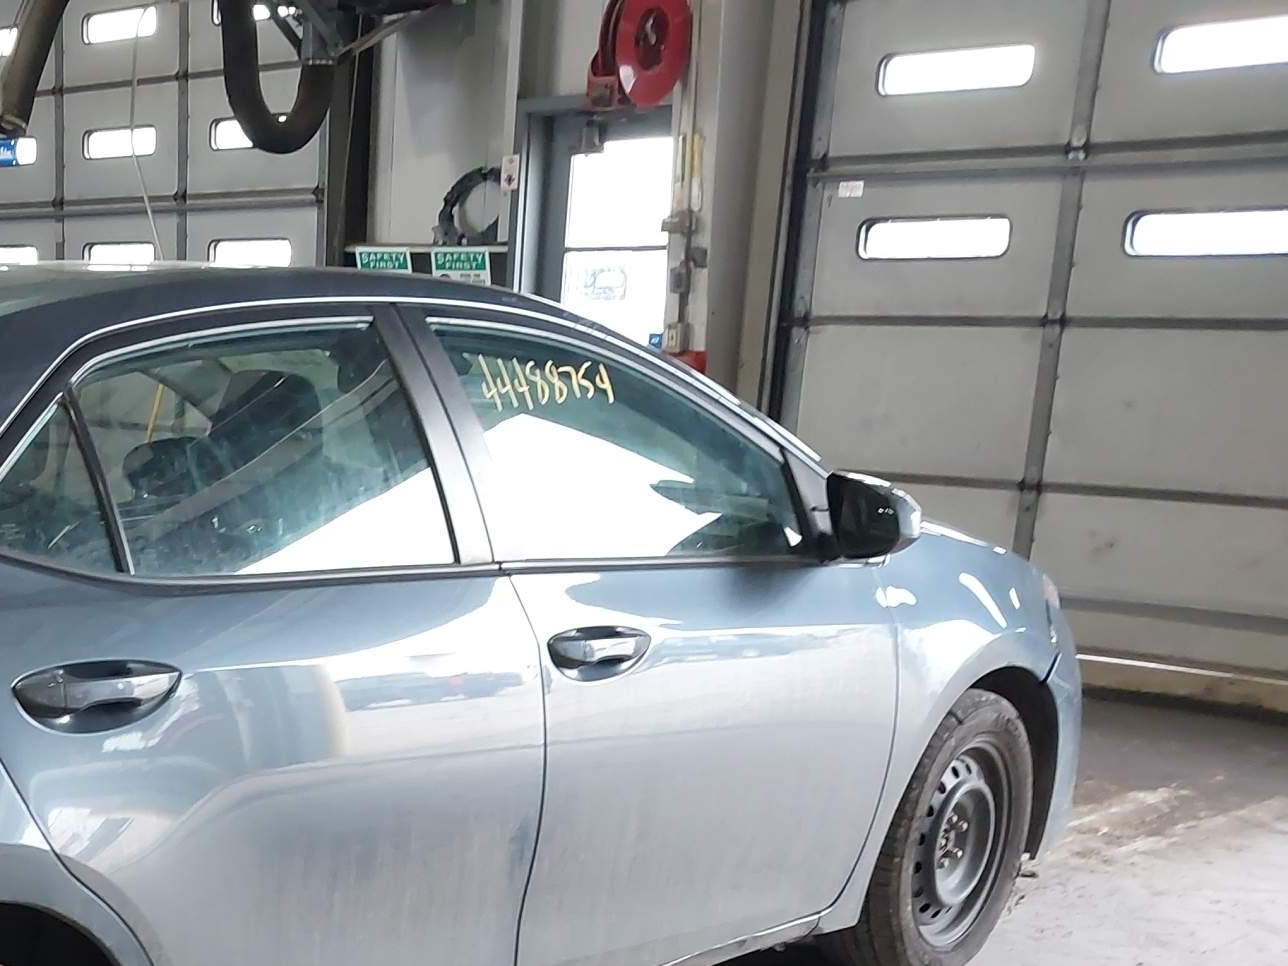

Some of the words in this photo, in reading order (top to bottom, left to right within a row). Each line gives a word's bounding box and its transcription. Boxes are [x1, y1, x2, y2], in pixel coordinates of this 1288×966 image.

[361, 252, 405, 264] SAFETY
[436, 252, 483, 264] SAFETY
[369, 261, 401, 270] FIRST
[445, 261, 478, 271] FIRST
[479, 353, 615, 412] 44488754
